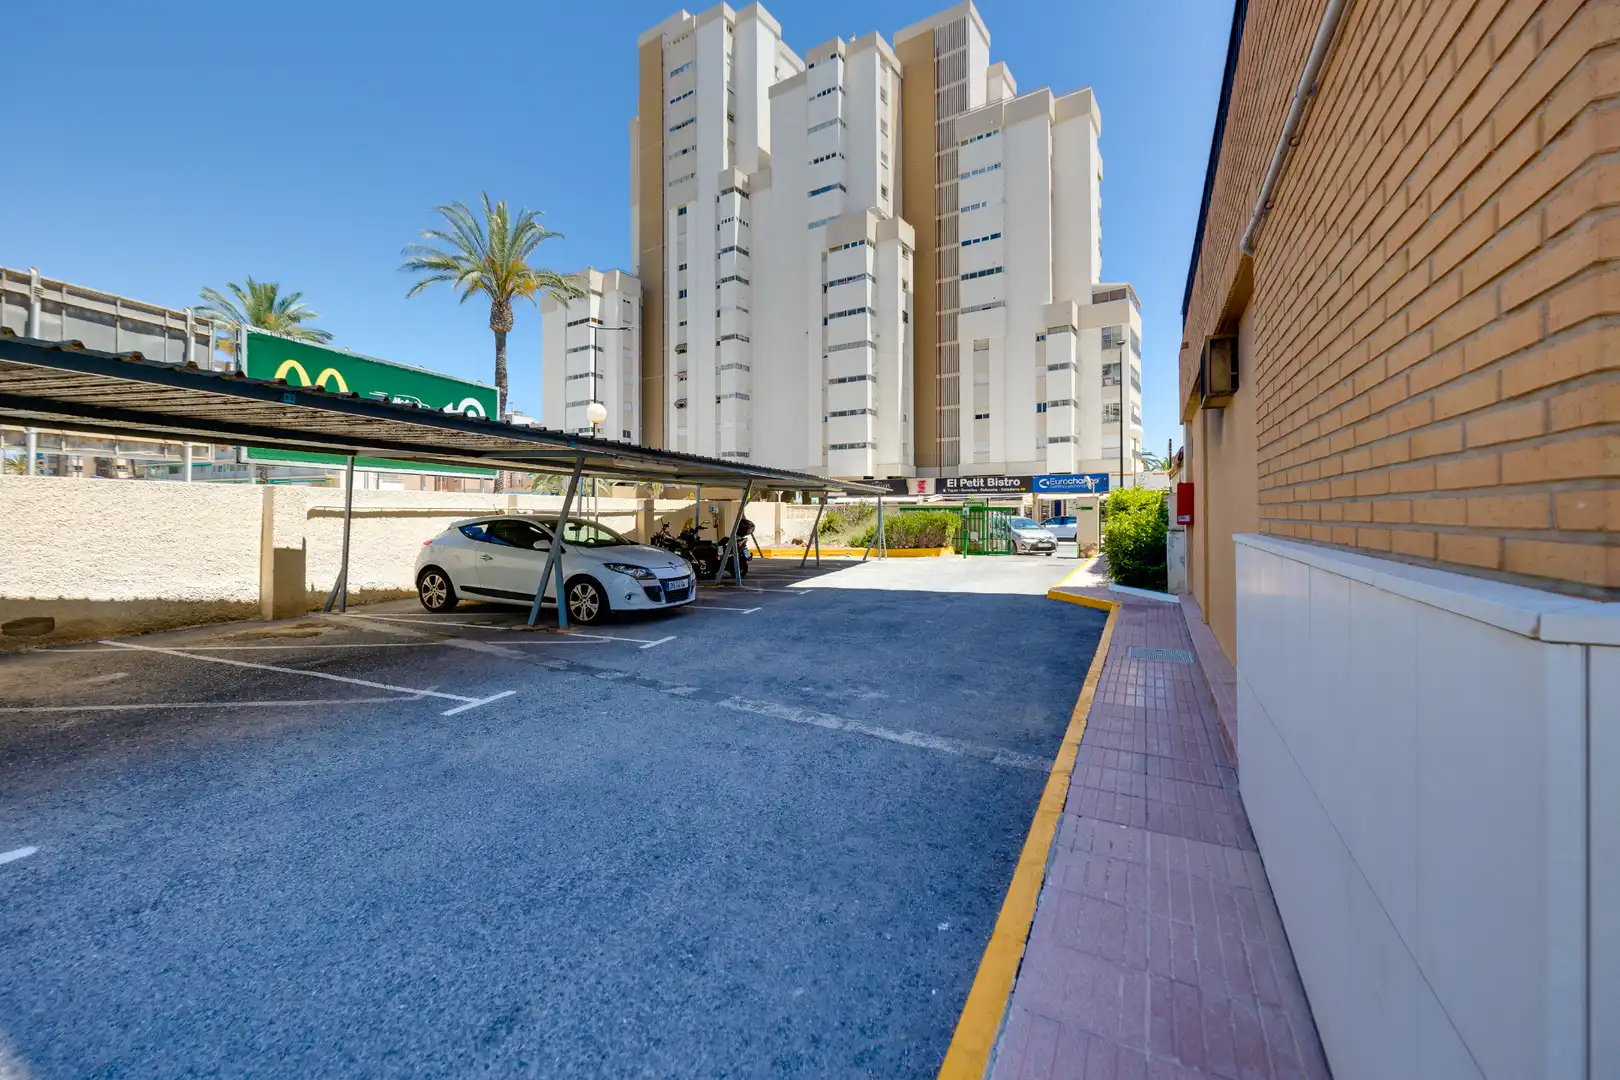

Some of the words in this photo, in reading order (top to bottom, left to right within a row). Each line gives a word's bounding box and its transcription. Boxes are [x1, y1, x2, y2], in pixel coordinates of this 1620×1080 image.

[946, 478, 957, 488] El
[959, 478, 985, 488] Petit
[987, 477, 1021, 487] Bistro
[1049, 477, 1100, 486] Eurochage
